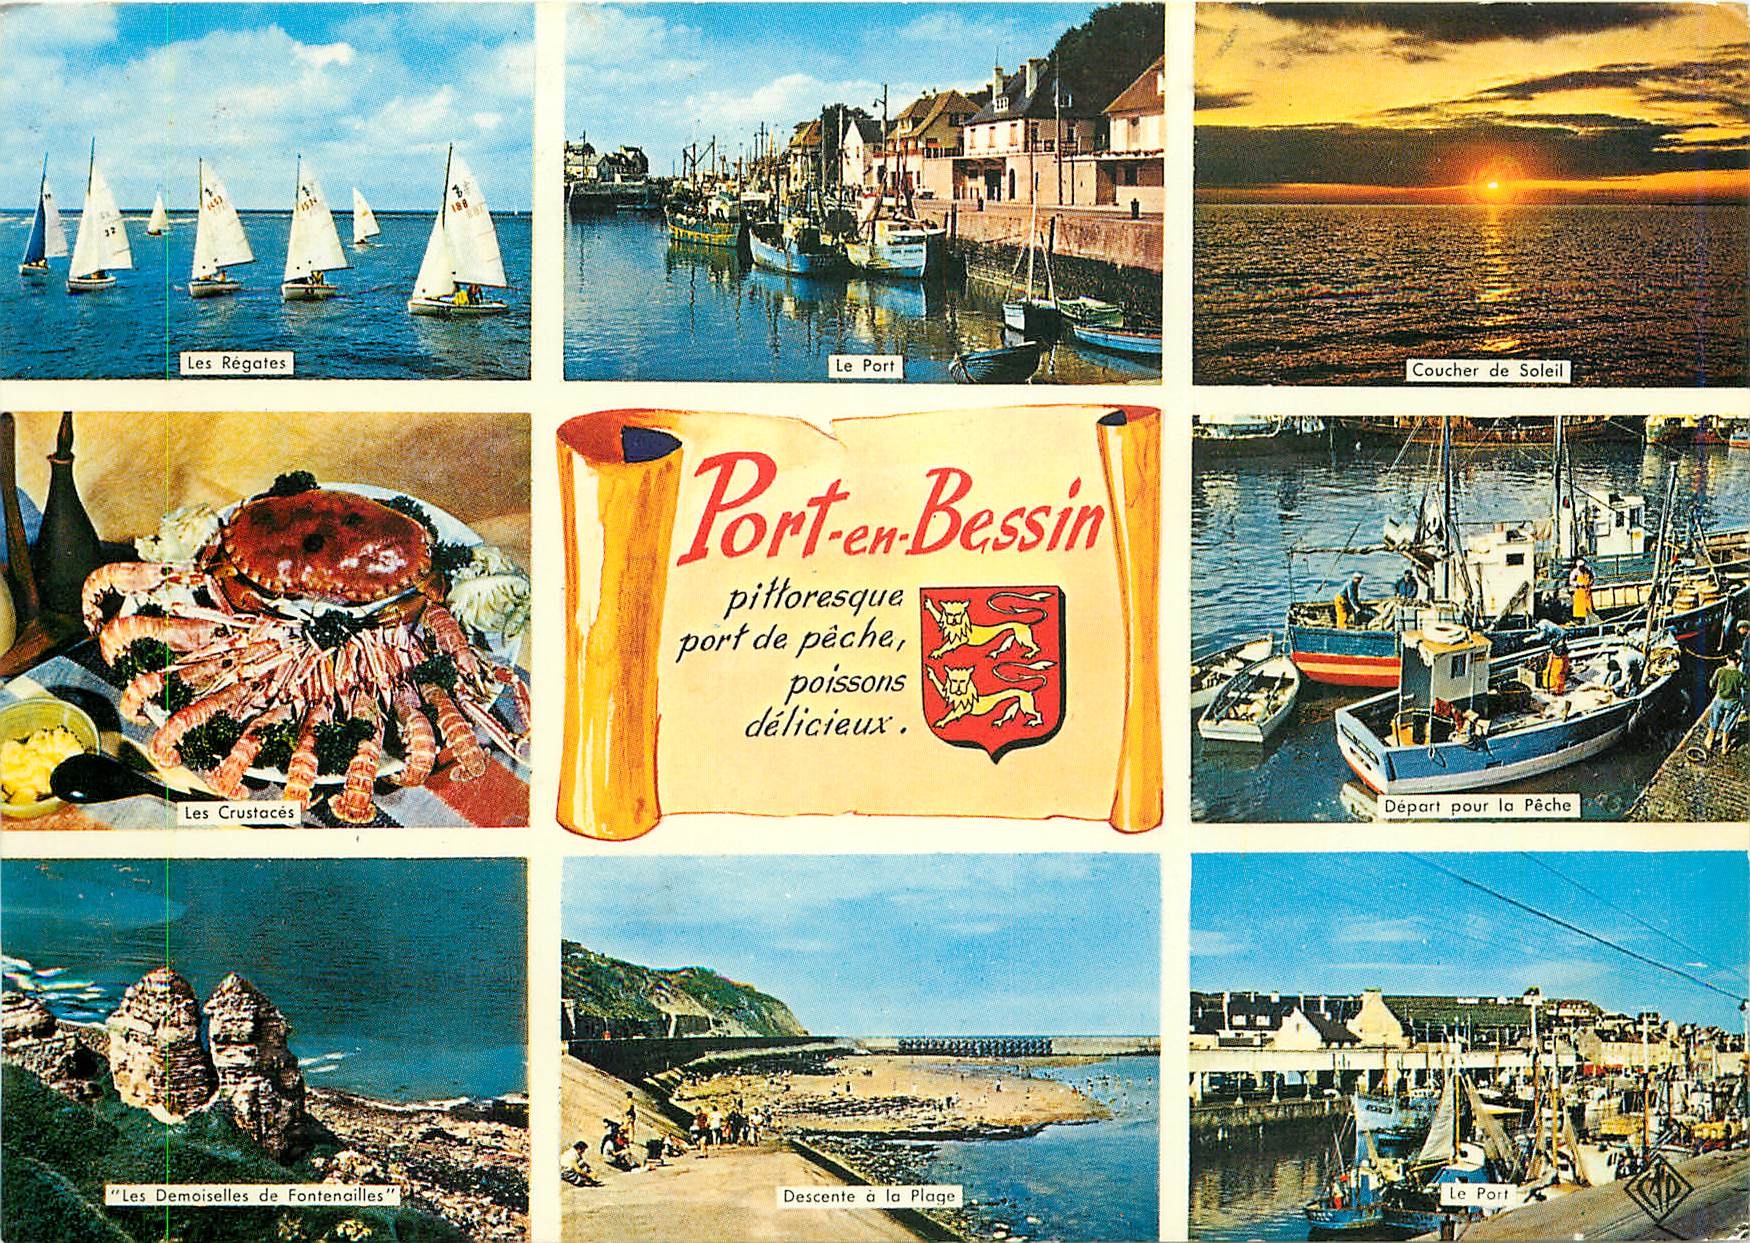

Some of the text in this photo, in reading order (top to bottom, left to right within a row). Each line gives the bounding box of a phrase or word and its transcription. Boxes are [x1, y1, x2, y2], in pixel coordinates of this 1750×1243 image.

[676, 451, 1106, 567] Port-en-Bessin
[723, 576, 904, 620] pittoresque
[675, 616, 906, 664] port de pêche,
[784, 663, 907, 706] poissons
